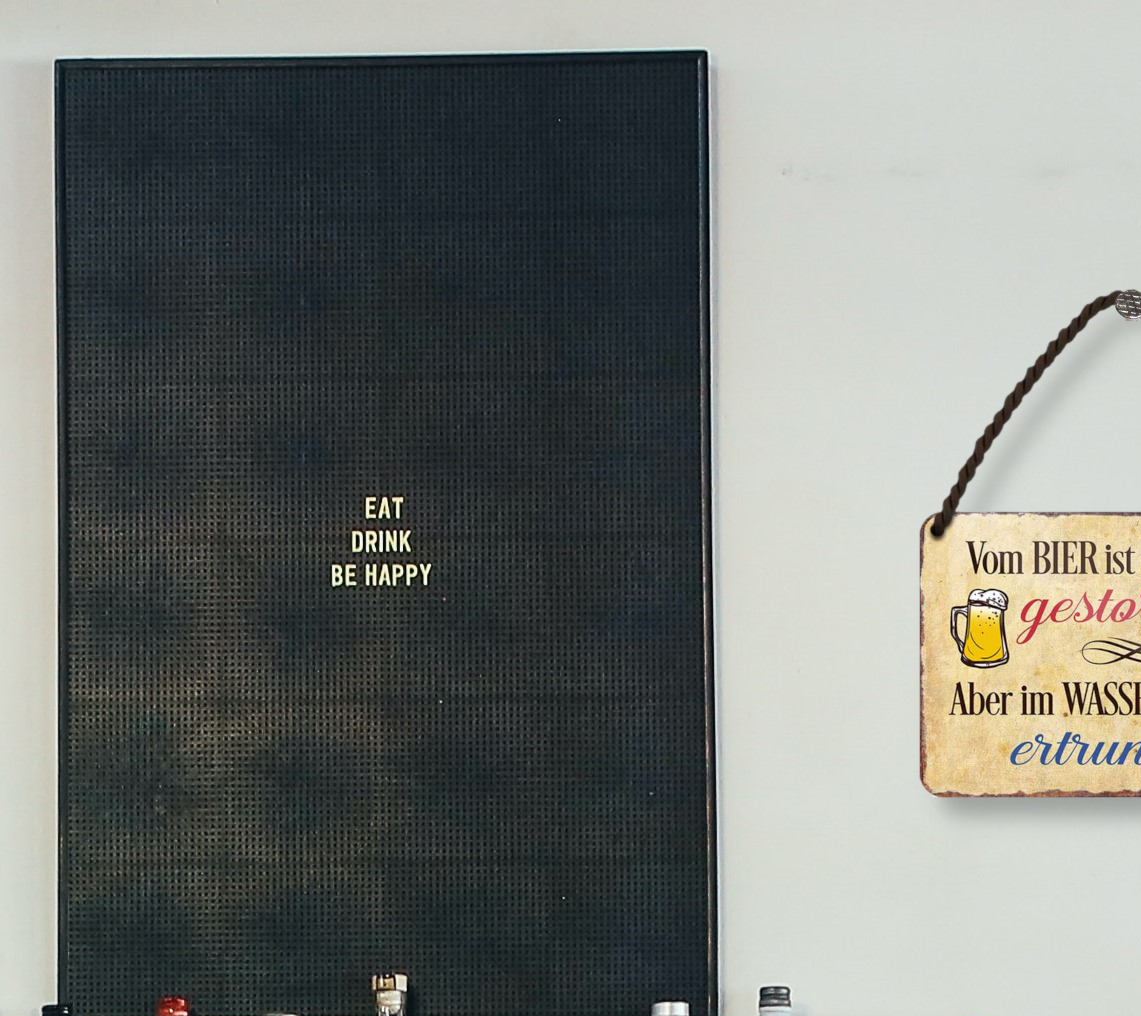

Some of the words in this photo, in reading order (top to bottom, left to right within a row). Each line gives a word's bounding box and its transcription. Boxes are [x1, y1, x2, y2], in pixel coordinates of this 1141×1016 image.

[365, 497, 404, 519] EAT
[351, 530, 411, 553] DRINK
[966, 541, 1023, 575] Vom
[1032, 541, 1098, 575] BIER
[1105, 546, 1135, 575] ist
[331, 564, 357, 587] BE
[365, 563, 432, 586] HAPPY
[949, 682, 1013, 716] Aber
[1020, 685, 1054, 716] im
